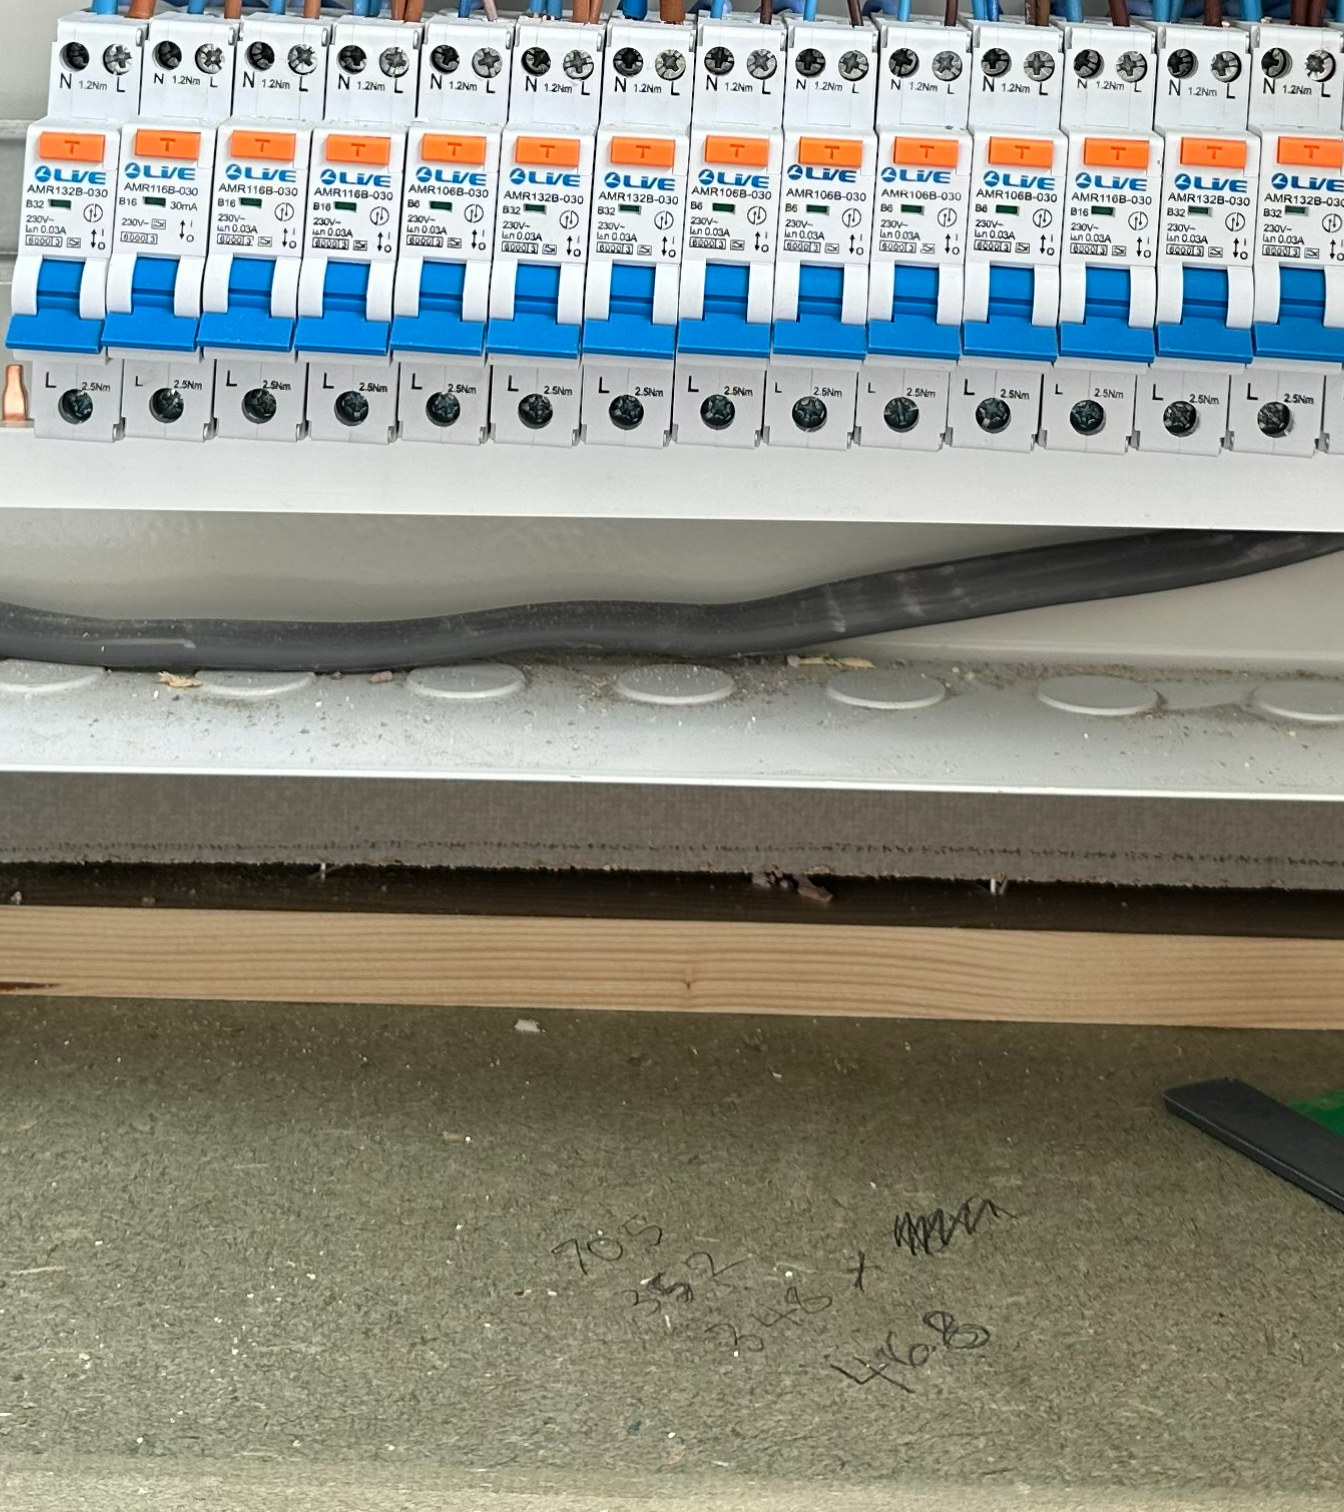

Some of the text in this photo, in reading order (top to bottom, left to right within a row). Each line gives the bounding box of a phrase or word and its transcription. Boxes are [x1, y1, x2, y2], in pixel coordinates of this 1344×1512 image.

[60, 73, 126, 93] N 1.2Nm L
[706, 75, 771, 95] N 1.2Nm L
[170, 201, 197, 211] 30mA
[45, 372, 111, 393] L 2.5Nm
[411, 373, 477, 394] L 2.5Nm
[963, 379, 1030, 400] L 2.5Nm
